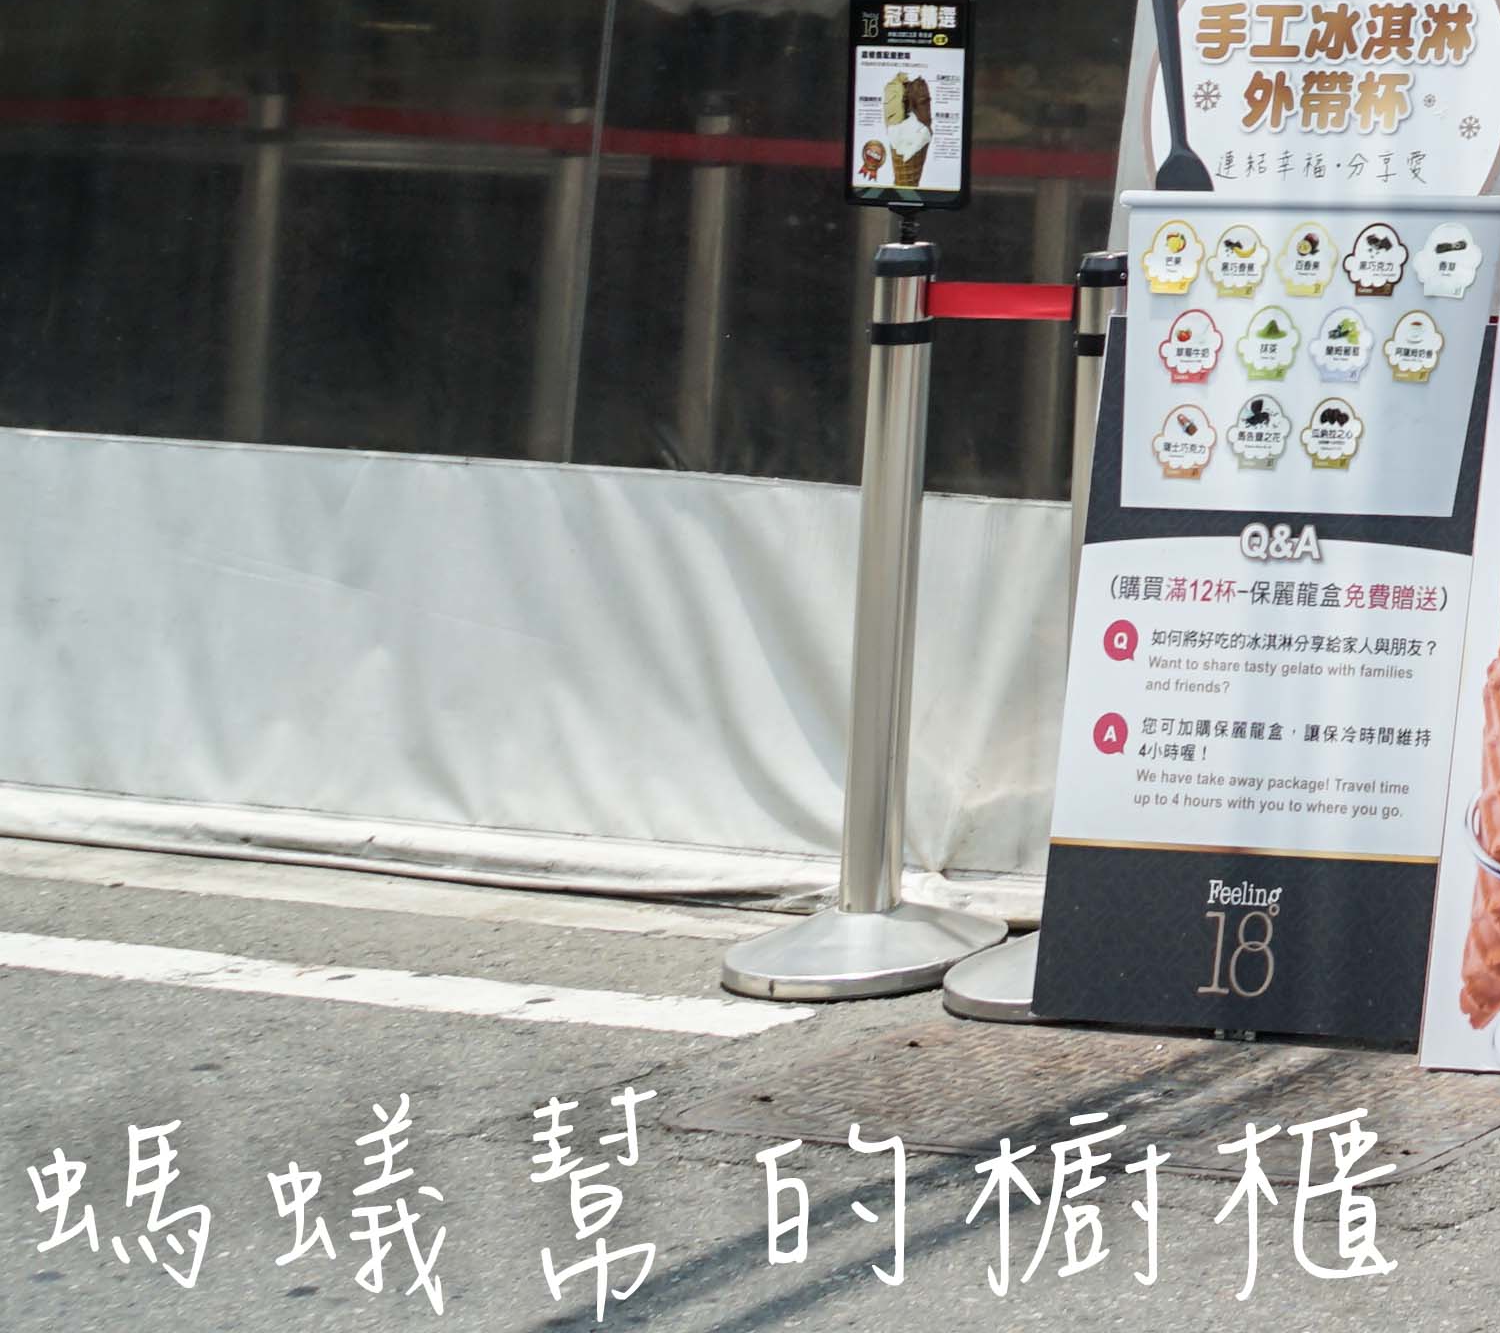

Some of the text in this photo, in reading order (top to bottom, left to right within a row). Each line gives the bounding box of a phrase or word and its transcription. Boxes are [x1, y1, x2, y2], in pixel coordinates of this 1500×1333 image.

[1196, 2, 1473, 62] 手工冰淇淋
[1242, 70, 1410, 130] 外帶杯
[1240, 524, 1322, 560] Q&A
[1110, 575, 1449, 612] (購買滿12杯-保麗龍盒免費贈送)
[1113, 633, 1128, 650] Q
[1148, 656, 1414, 680] Want to share tasty gelato with families
[1145, 679, 1230, 694] and friends?
[1104, 726, 1117, 742] A
[1135, 769, 1410, 795] We have take away package! Travel time
[1134, 792, 1403, 819] up to 4 hours with you to where you go.
[1207, 879, 1282, 906] Feeling
[1198, 911, 1274, 997] 18
